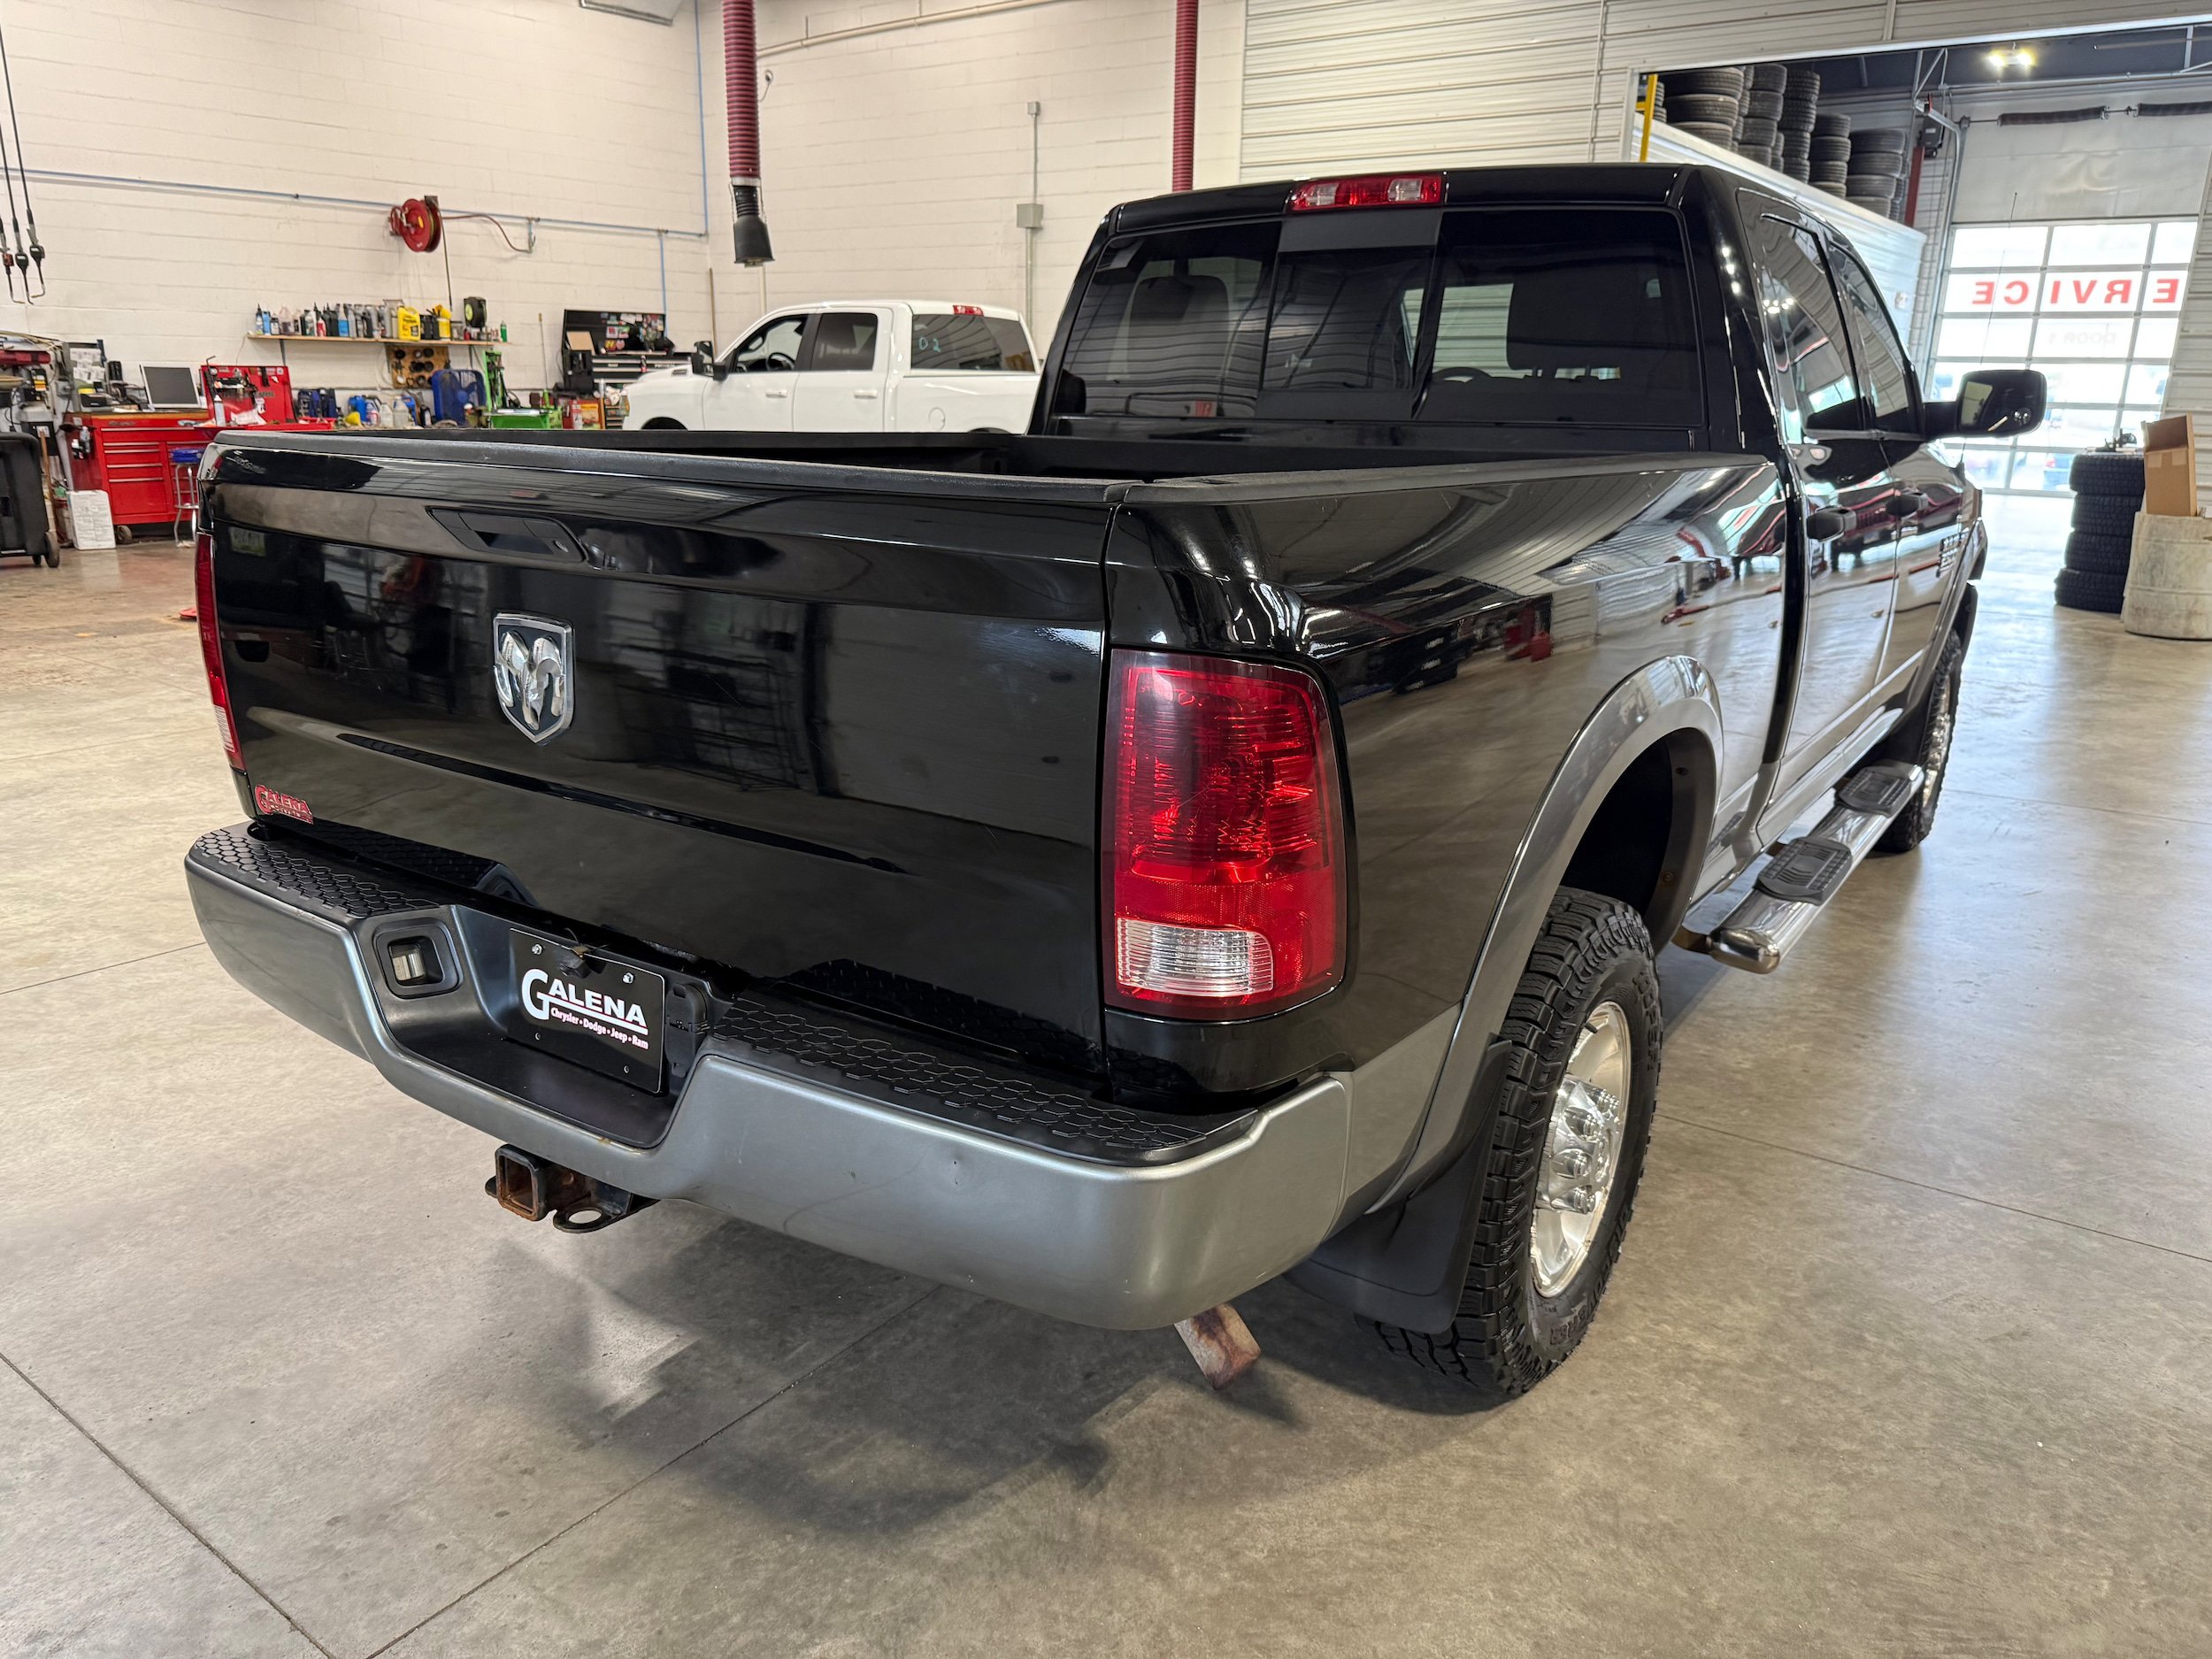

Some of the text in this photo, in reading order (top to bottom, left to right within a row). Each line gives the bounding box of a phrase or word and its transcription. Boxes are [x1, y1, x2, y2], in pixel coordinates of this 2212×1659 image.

[255, 785, 313, 816] GALENA
[522, 969, 648, 1027] GALENA
[550, 1006, 649, 1050] Chrysler Dodge Jeep Ram
